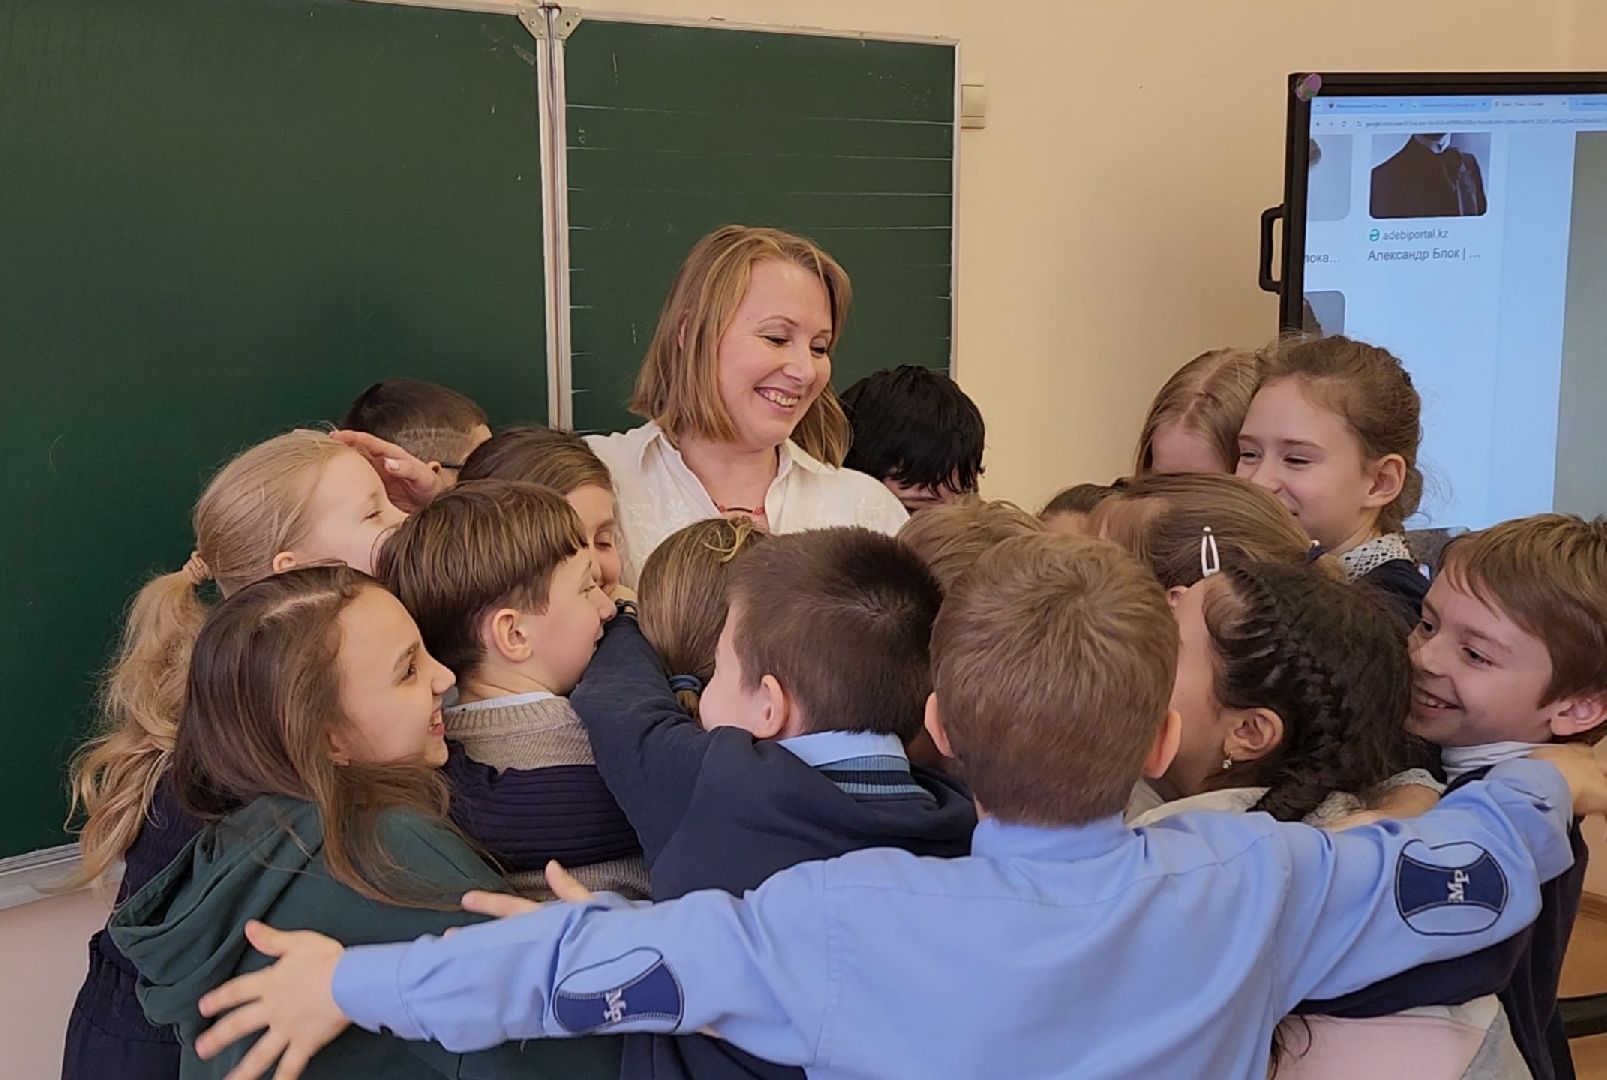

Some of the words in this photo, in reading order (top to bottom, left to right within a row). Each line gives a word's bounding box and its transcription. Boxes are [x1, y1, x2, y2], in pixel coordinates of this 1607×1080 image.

[1383, 228, 1449, 241] adebiportal.kz
[1368, 248, 1429, 261] Александр
[1433, 247, 1460, 259] Блок
